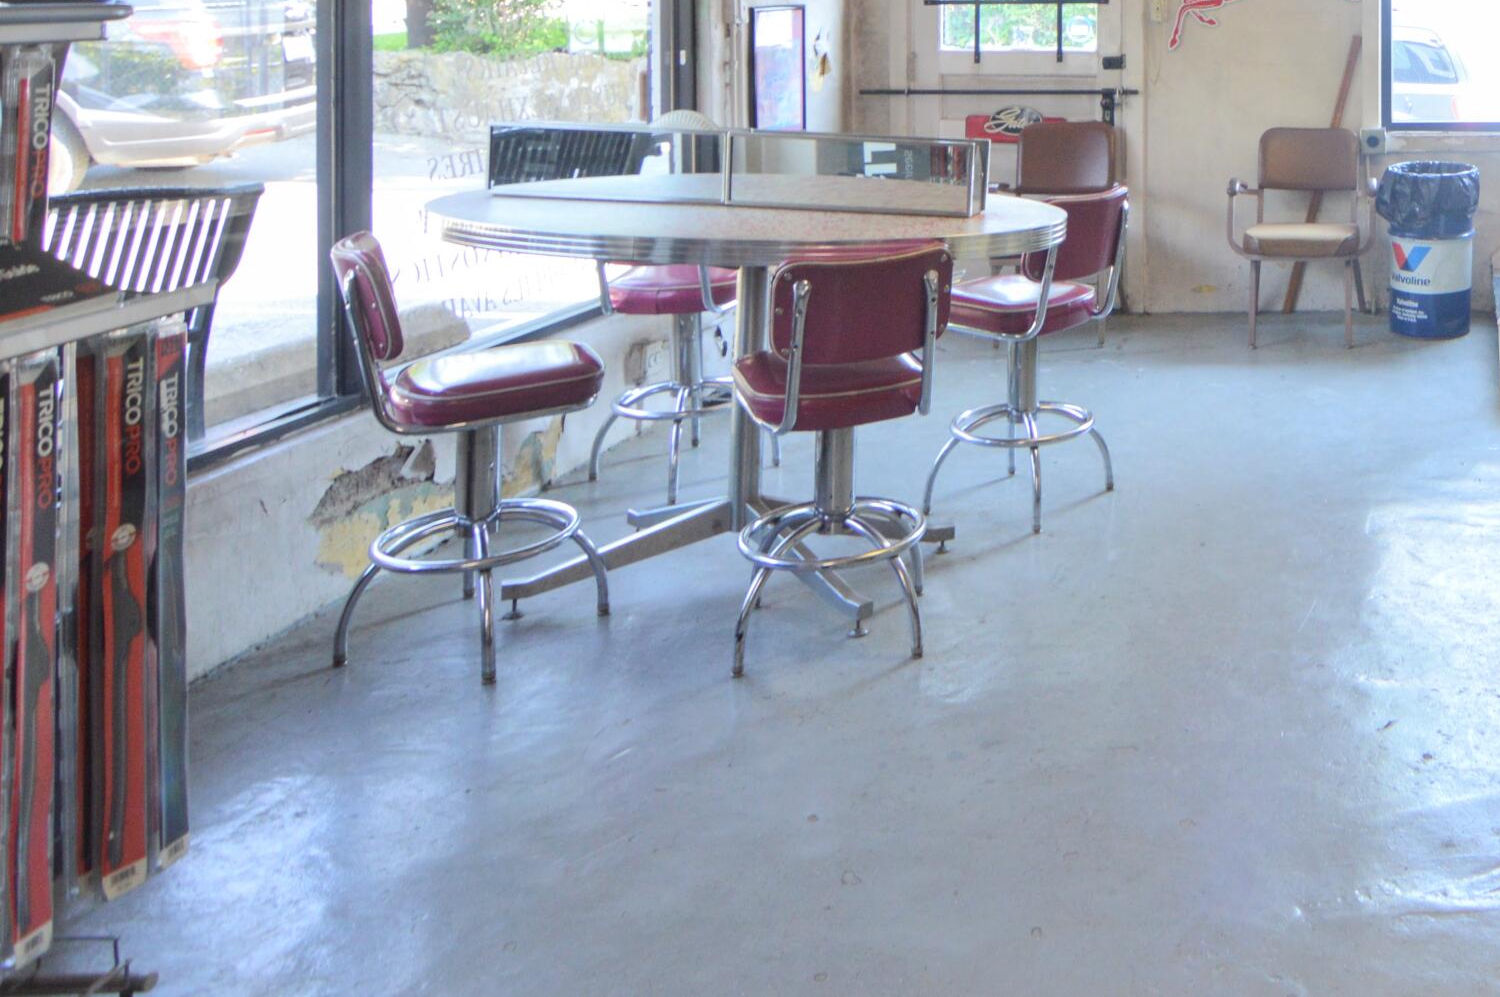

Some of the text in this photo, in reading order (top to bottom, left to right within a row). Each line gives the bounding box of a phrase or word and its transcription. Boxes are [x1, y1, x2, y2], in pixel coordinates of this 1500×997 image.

[33, 83, 50, 150] TRICO
[37, 385, 54, 510] TRICO PRO
[125, 356, 143, 475] TRICO PRO
[162, 372, 179, 487] TRICO PRO
